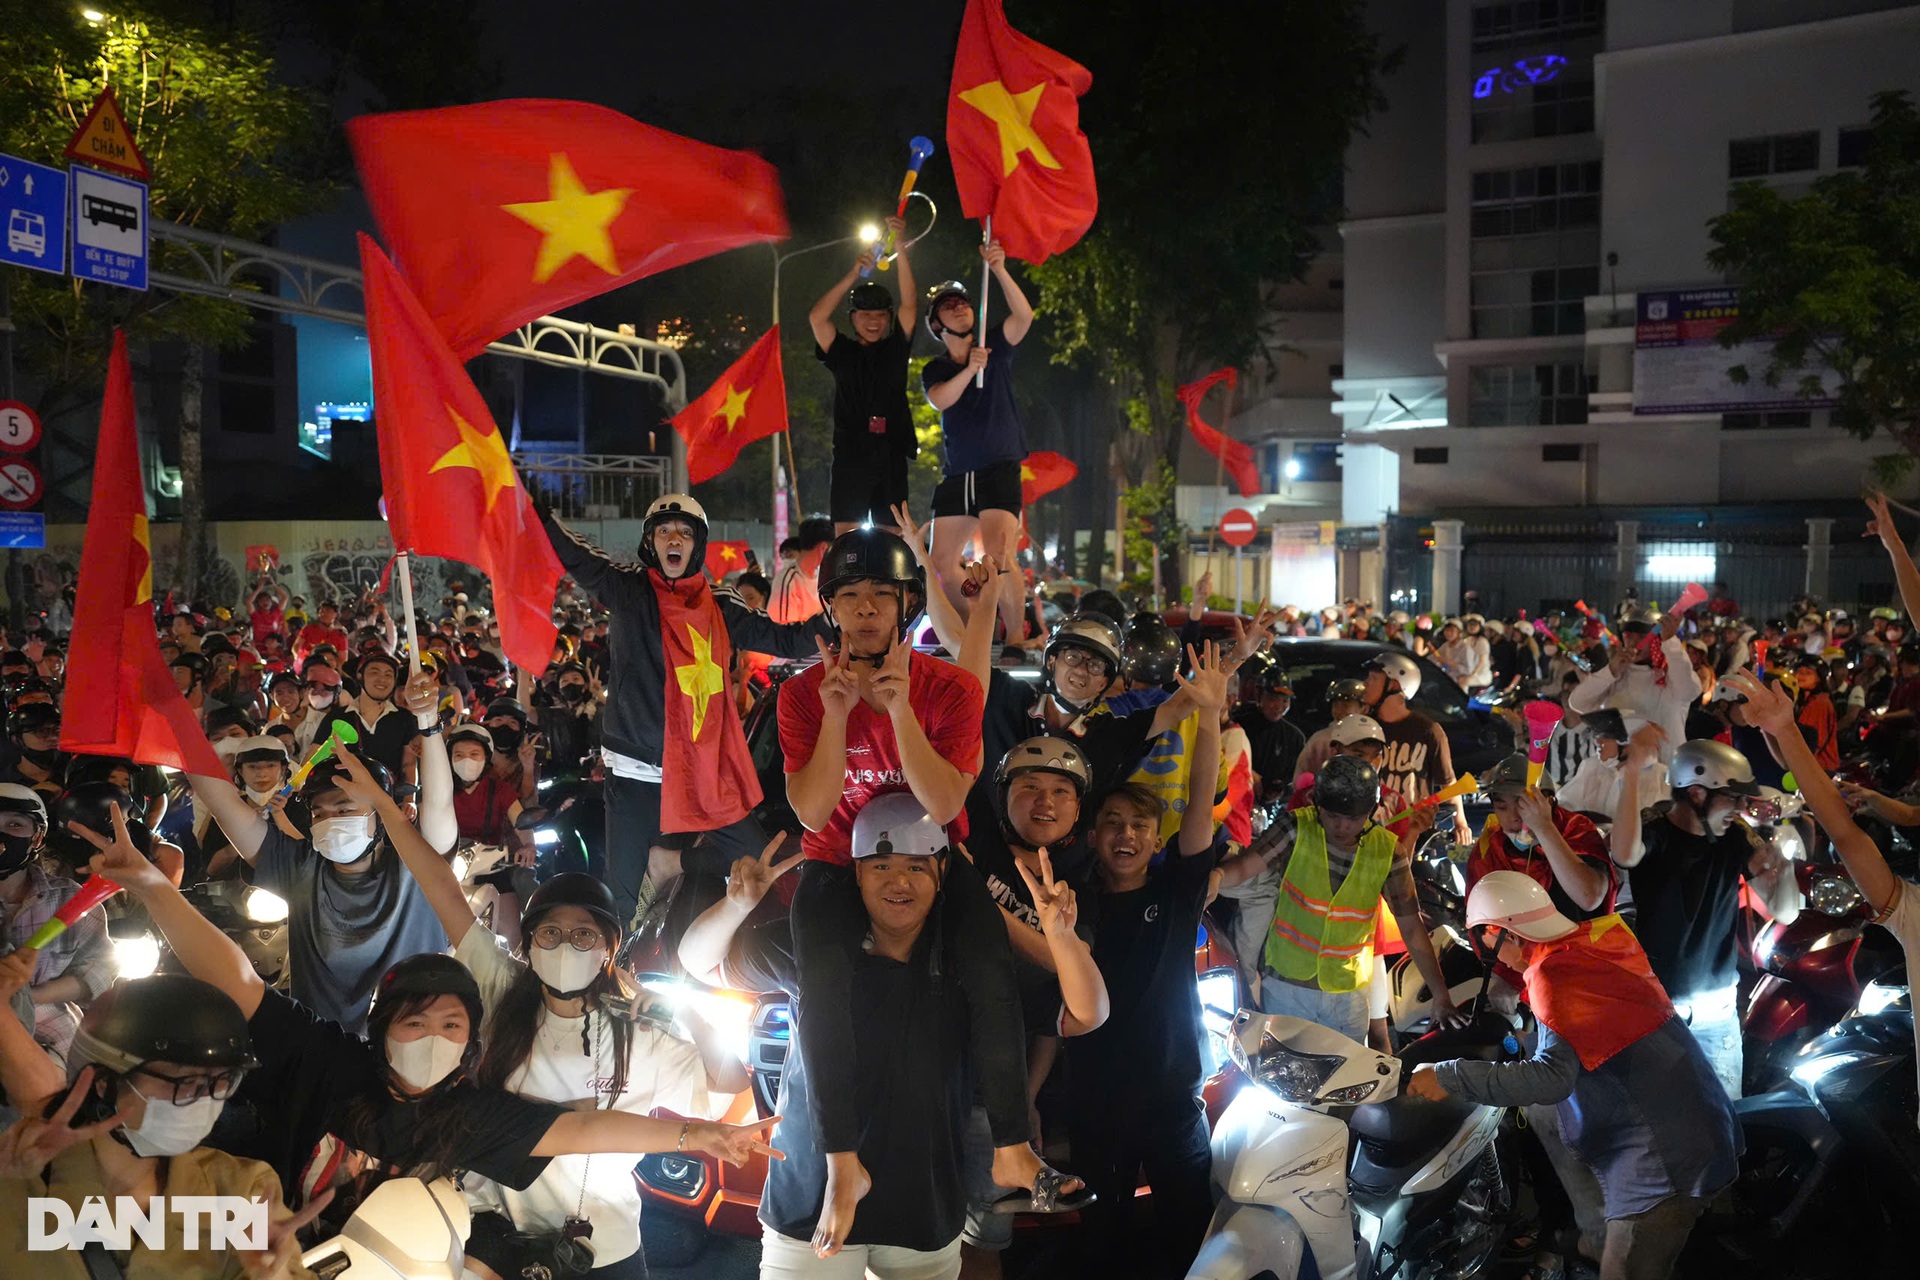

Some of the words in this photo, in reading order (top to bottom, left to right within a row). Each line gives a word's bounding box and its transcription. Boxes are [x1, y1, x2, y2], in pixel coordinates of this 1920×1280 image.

[103, 117, 115, 133] ĐI
[92, 137, 126, 160] CHẬM
[104, 254, 115, 265] XE
[92, 264, 108, 277] BUS
[110, 268, 130, 281] STOP
[9, 416, 18, 437] 5
